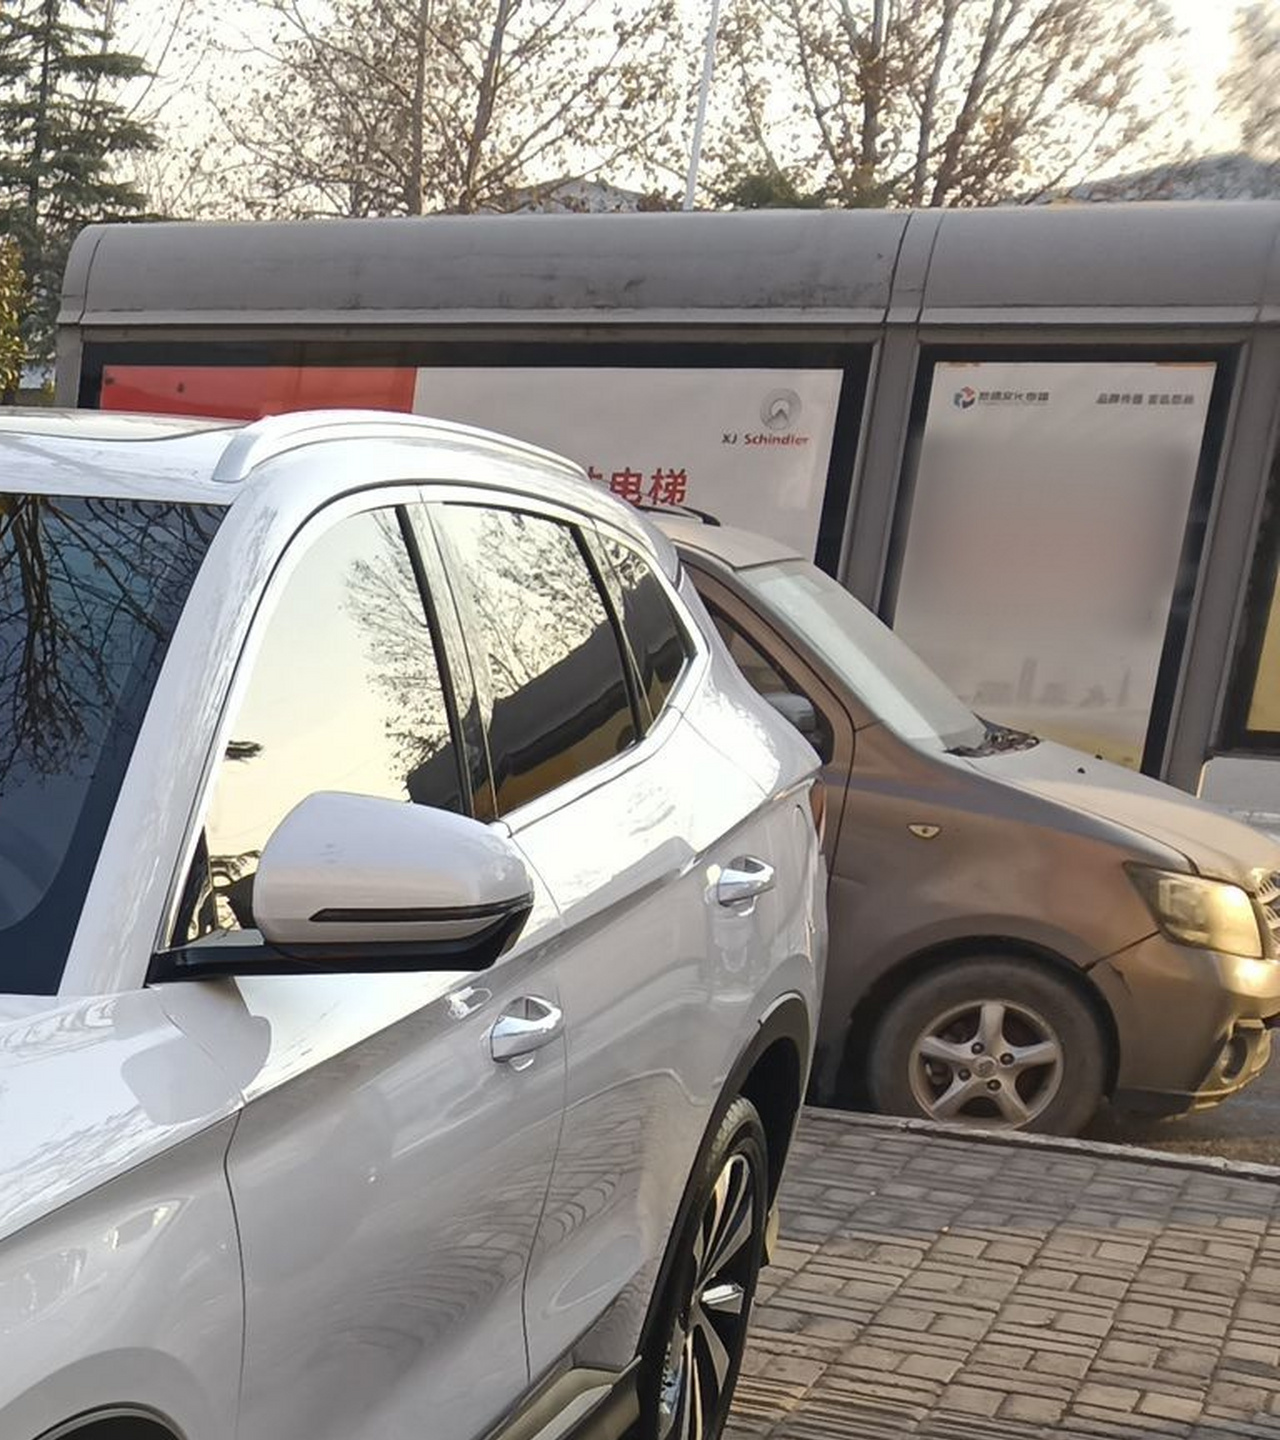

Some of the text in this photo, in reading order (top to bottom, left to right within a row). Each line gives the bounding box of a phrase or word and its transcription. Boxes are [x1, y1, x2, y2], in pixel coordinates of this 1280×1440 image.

[721, 433, 809, 446] XJ Schindler
[588, 466, 688, 506] 电梯
